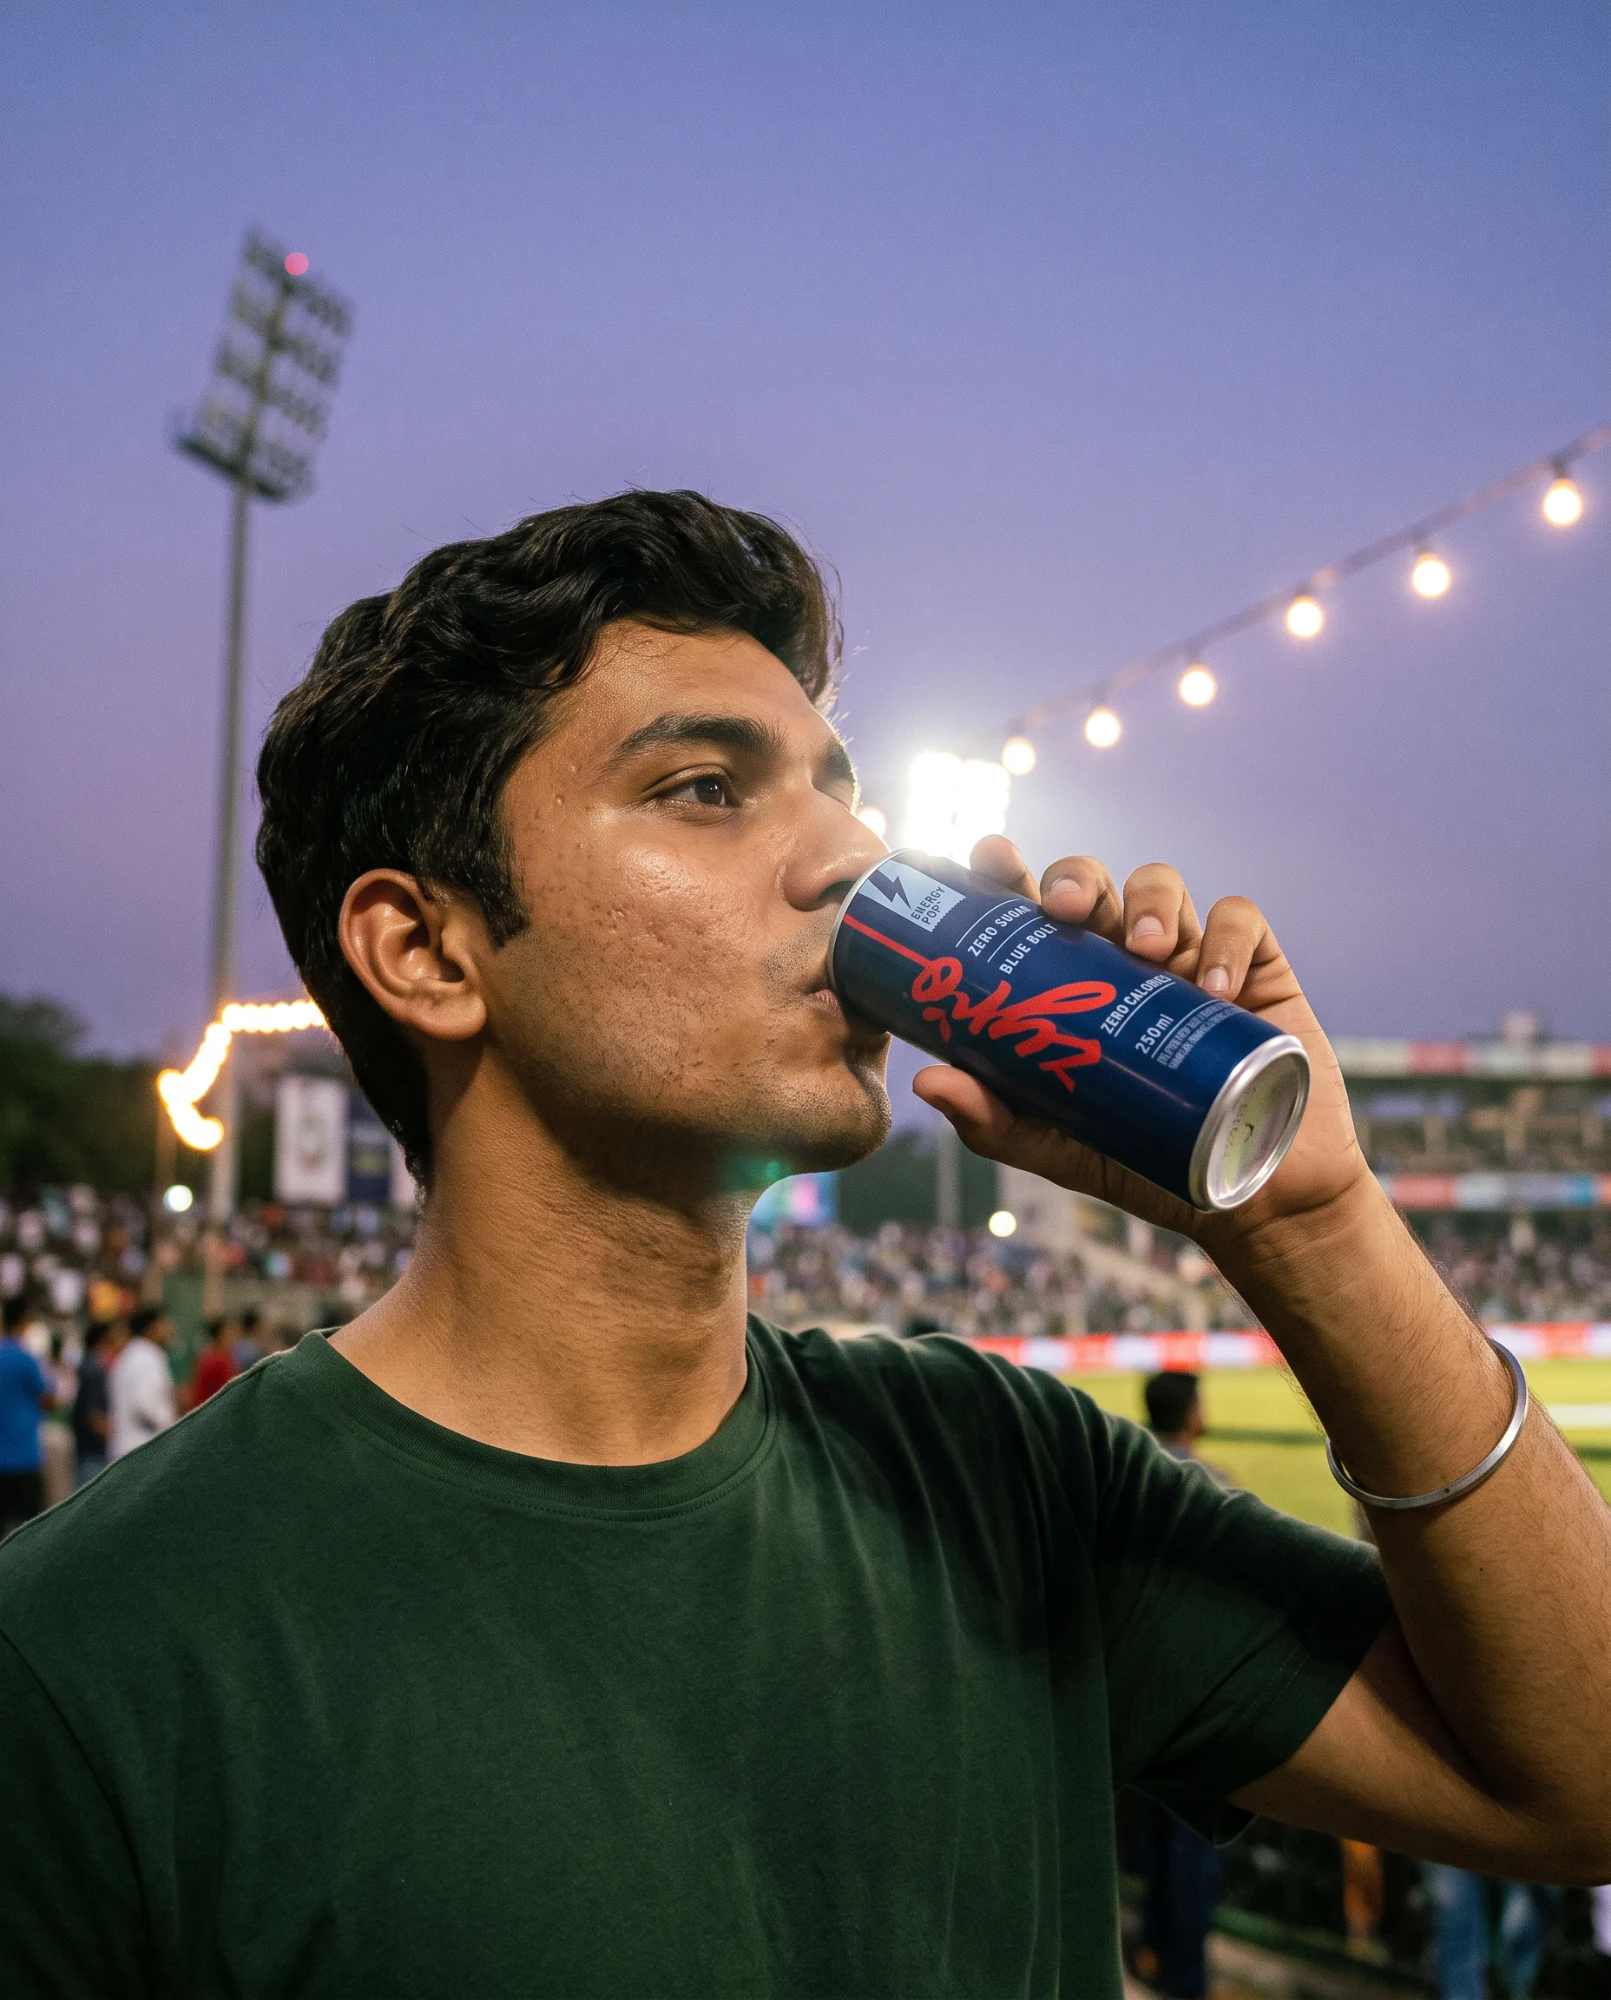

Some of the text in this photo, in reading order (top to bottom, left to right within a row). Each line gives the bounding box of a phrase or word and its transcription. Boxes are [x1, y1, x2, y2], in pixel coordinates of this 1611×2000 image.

[967, 926, 998, 957] ZERO
[999, 923, 1058, 975] BLUE BOLT
[1100, 1004, 1130, 1035] ZERO
[1135, 1013, 1175, 1055] 250ml
